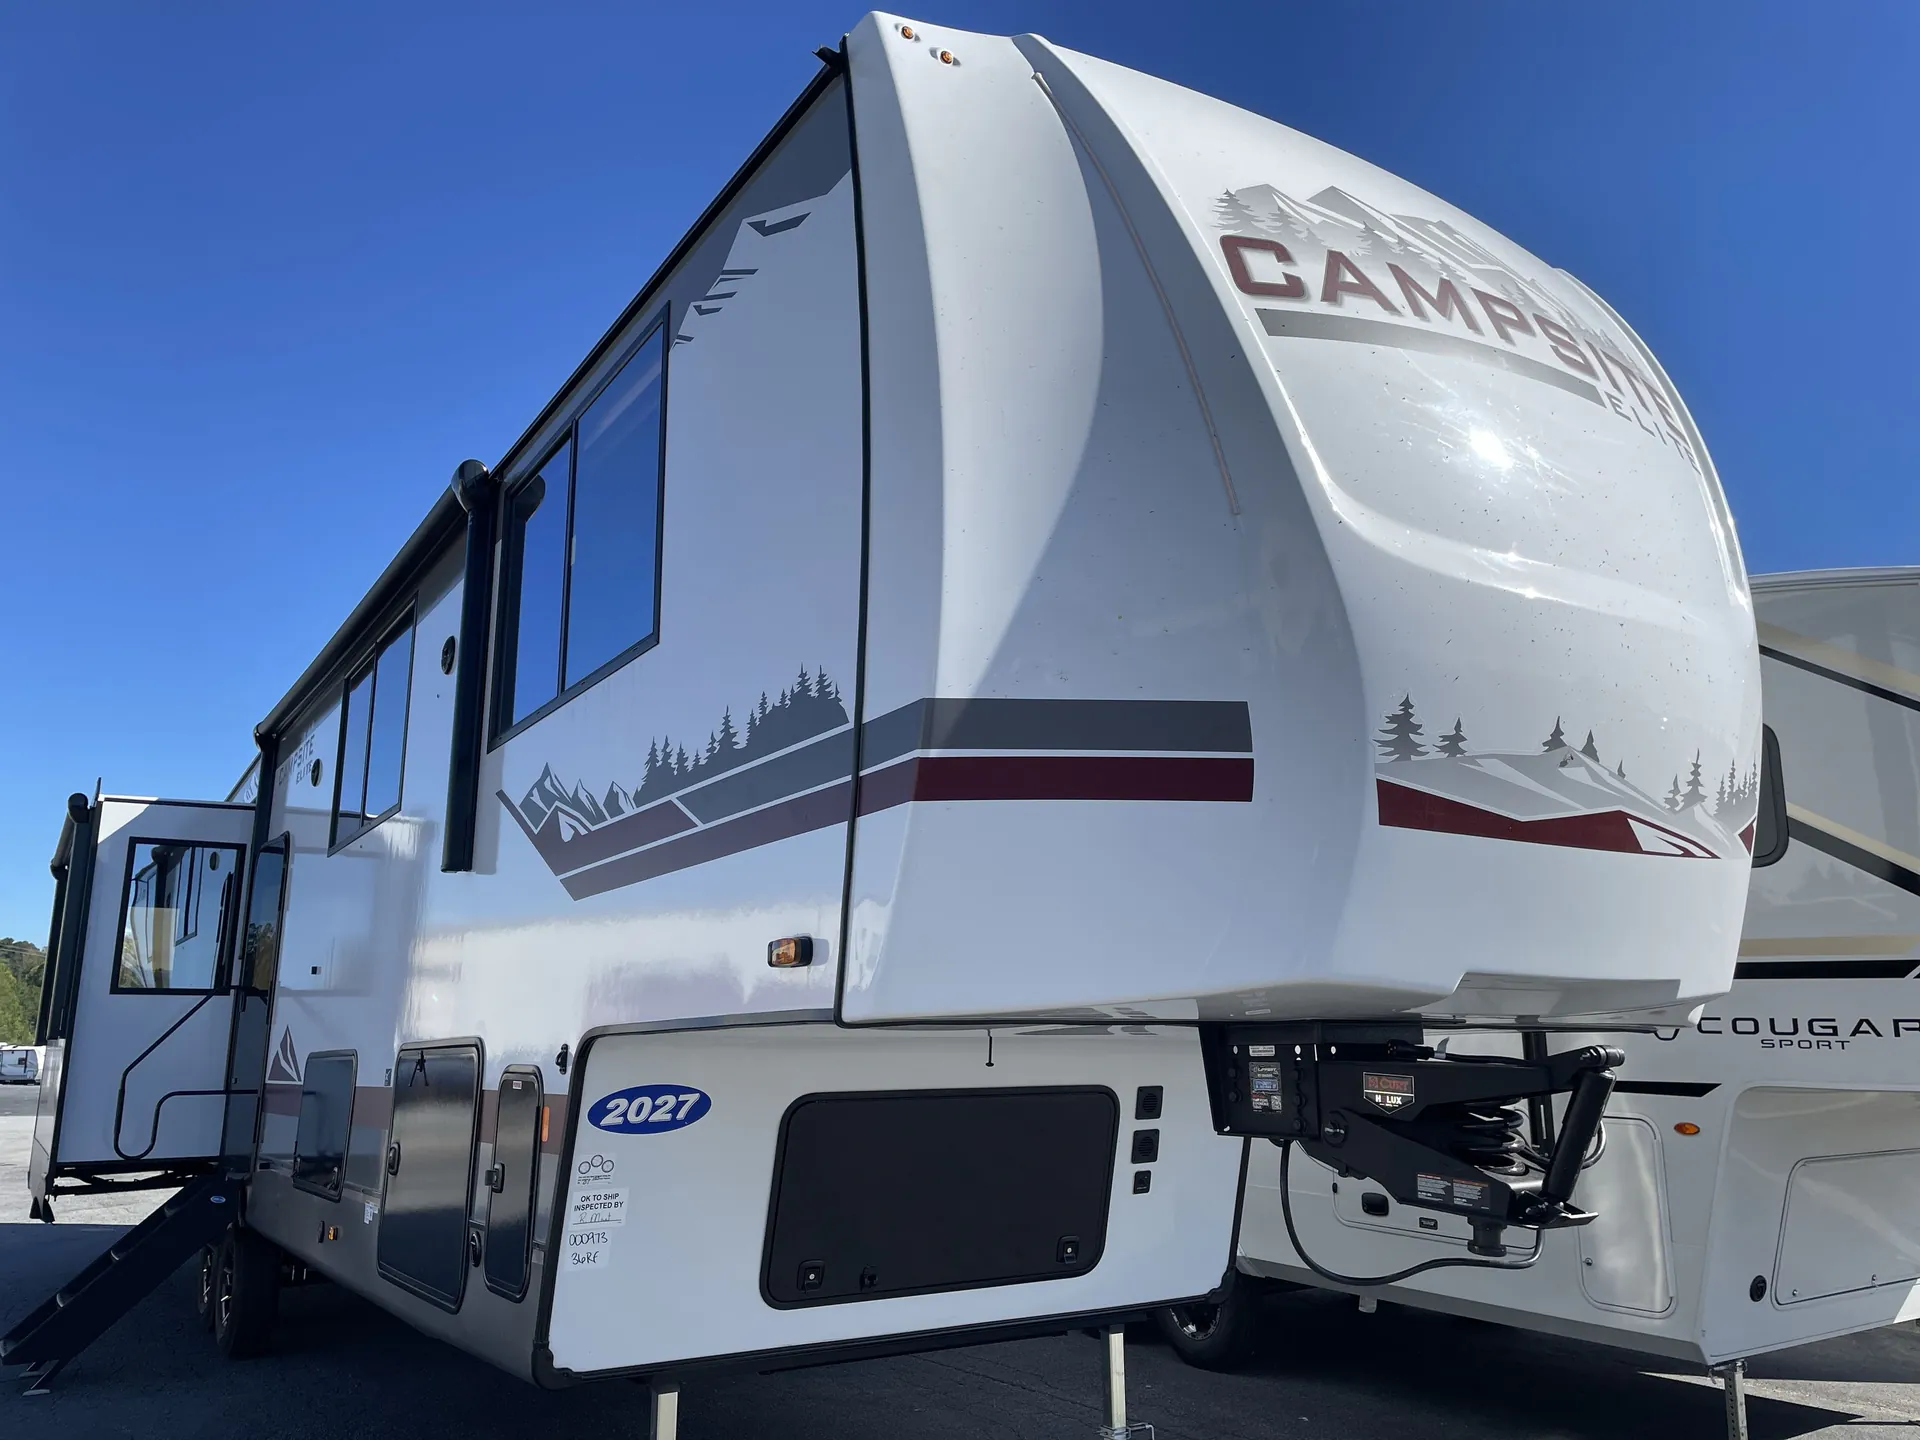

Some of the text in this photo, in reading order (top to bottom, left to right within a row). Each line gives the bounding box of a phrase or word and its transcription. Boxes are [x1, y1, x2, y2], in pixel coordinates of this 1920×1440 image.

[1219, 234, 1692, 449] CAMPSITE
[1604, 390, 1702, 475] ELITE
[1697, 1017, 1920, 1038] COUGAR
[1760, 1038, 1850, 1050] SPORT
[600, 1093, 700, 1127] 2027
[603, 1193, 620, 1201] SHIP
[574, 1202, 613, 1211] INSPECTED
[569, 1231, 608, 1247] 000973
